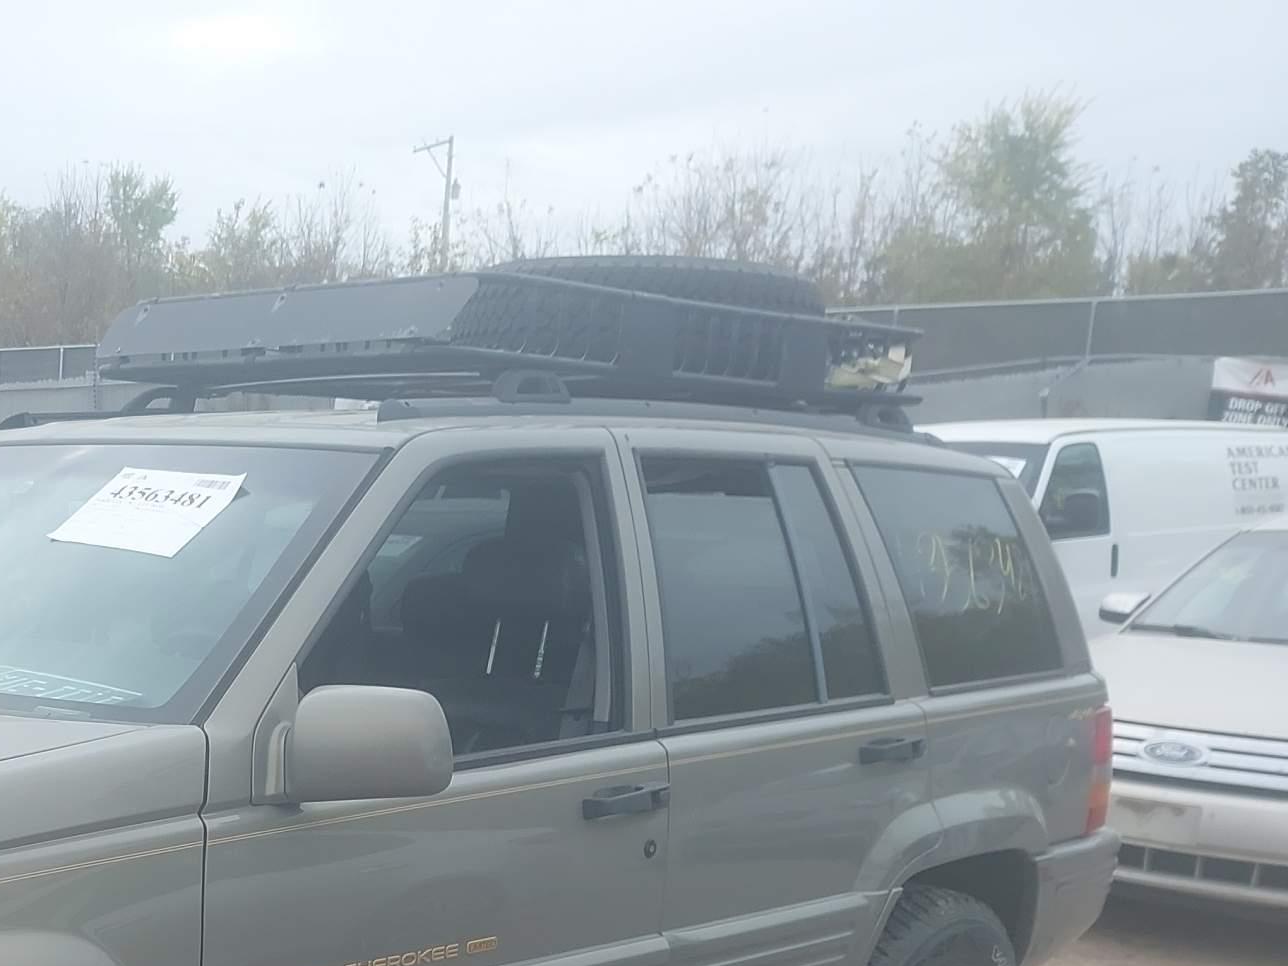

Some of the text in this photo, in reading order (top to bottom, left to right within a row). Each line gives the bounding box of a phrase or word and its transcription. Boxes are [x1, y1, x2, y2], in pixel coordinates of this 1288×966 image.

[1227, 396, 1263, 413] DROP
[1229, 460, 1260, 475] TEST
[1231, 476, 1281, 491] CENTER
[109, 484, 213, 509] 43563481
